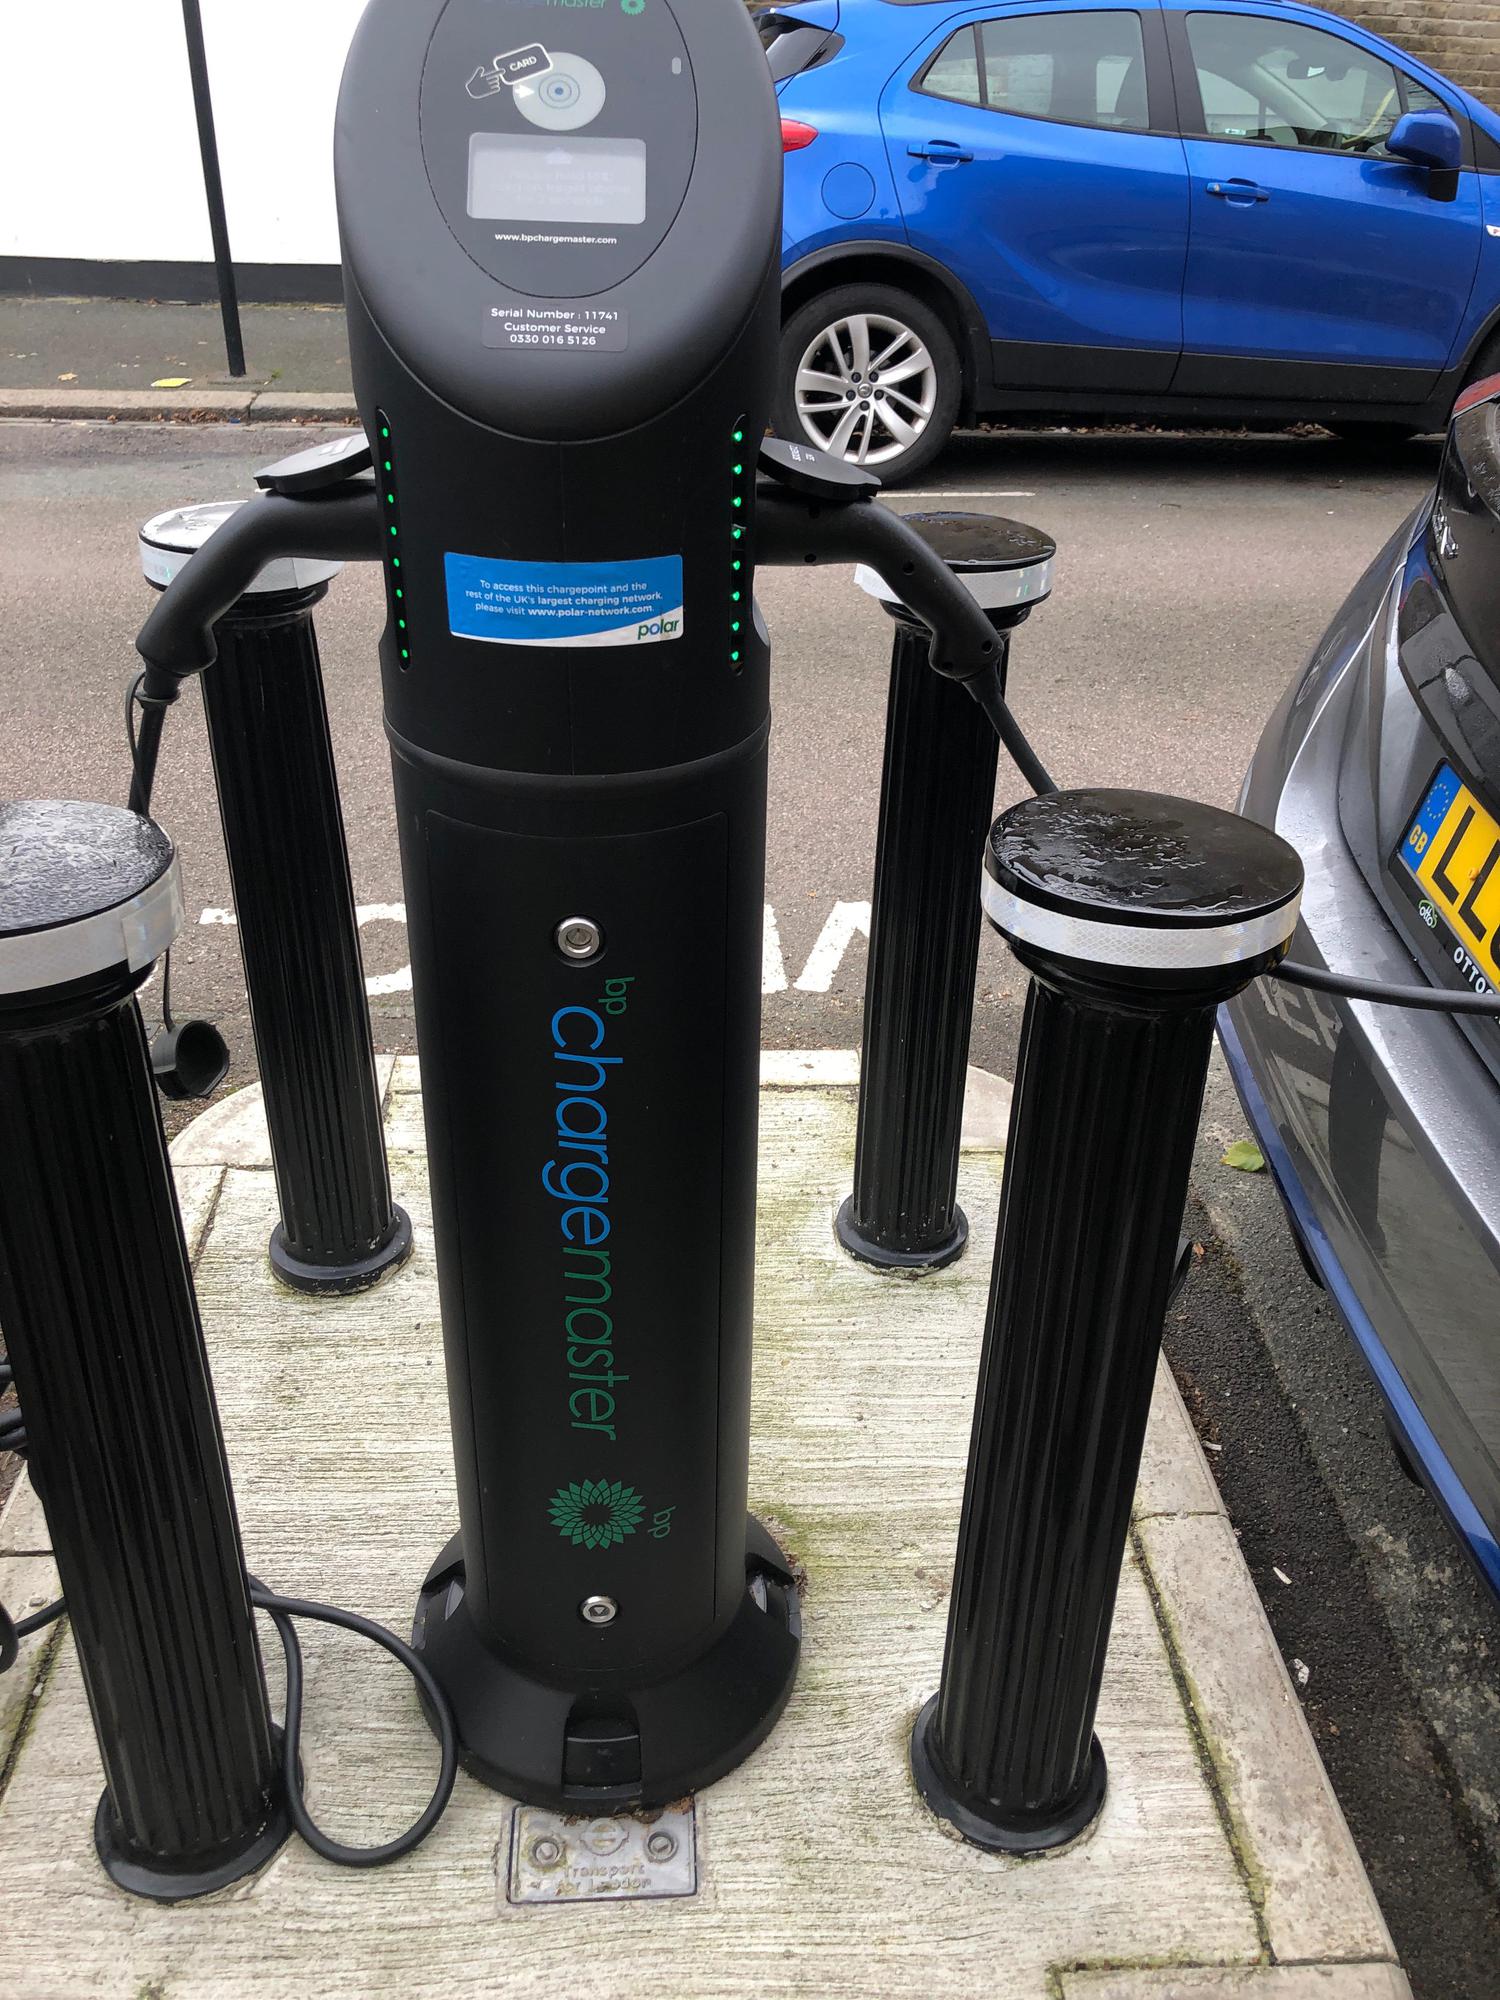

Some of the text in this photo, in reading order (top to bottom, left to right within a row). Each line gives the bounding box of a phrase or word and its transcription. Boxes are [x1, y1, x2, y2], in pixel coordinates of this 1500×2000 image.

[510, 56, 537, 71] CARD
[494, 233, 617, 245] www.bpchargemaster.com
[491, 308, 523, 318] Serial
[527, 309, 575, 319] Number
[585, 311, 618, 320] 11741
[504, 322, 606, 334] Customer Service
[510, 334, 597, 345] 0330 016 5126
[480, 580, 648, 595] To access this chargepoint and the
[465, 589, 482, 599] rest
[484, 592, 494, 600] of
[495, 593, 511, 603] the
[513, 595, 535, 604] UK's
[538, 596, 573, 606] largest
[575, 596, 620, 606] charging
[475, 602, 504, 613] please
[506, 605, 526, 615] visit
[637, 618, 680, 640] polar
[1408, 824, 1429, 854] GB
[1453, 946, 1494, 994] OTTO
[598, 976, 635, 1015] bp
[541, 1005, 630, 1441] chargemaster
[648, 1505, 677, 1538] bp
